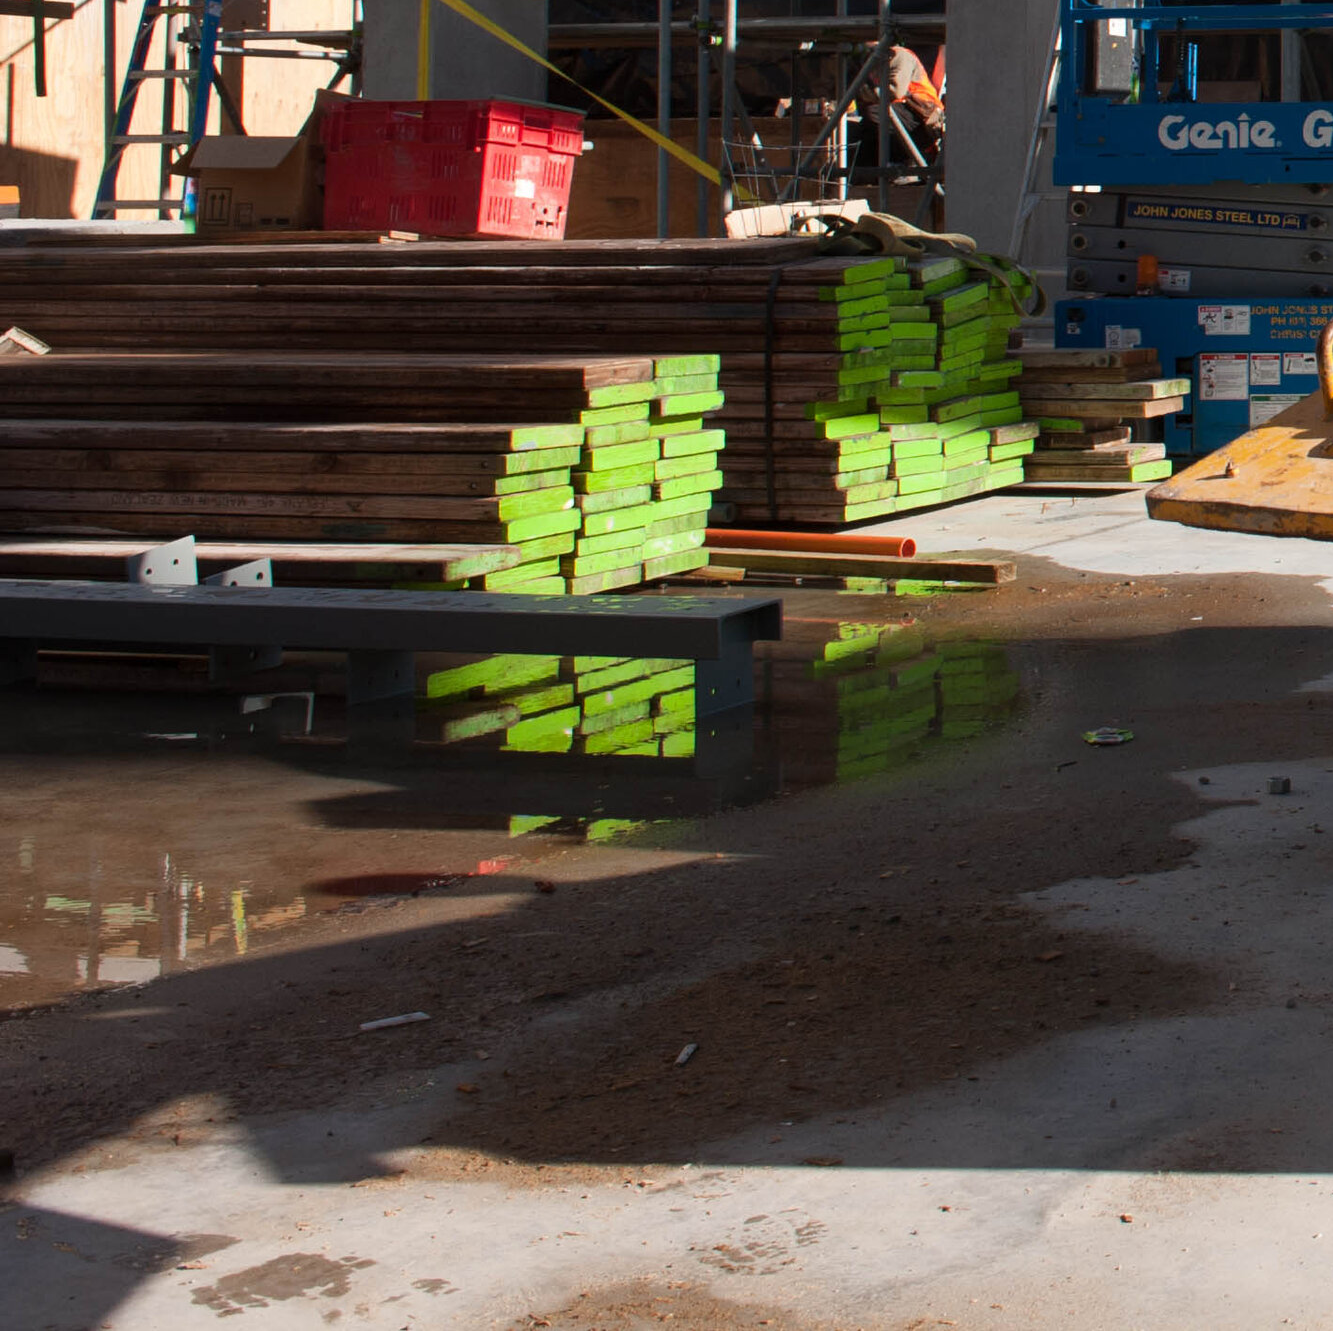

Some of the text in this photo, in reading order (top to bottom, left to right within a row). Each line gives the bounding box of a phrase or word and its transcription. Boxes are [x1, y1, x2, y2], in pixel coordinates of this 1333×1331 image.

[1158, 112, 1277, 150] Genie
[1134, 204, 1280, 226] JOHN JONES STEEL LTD
